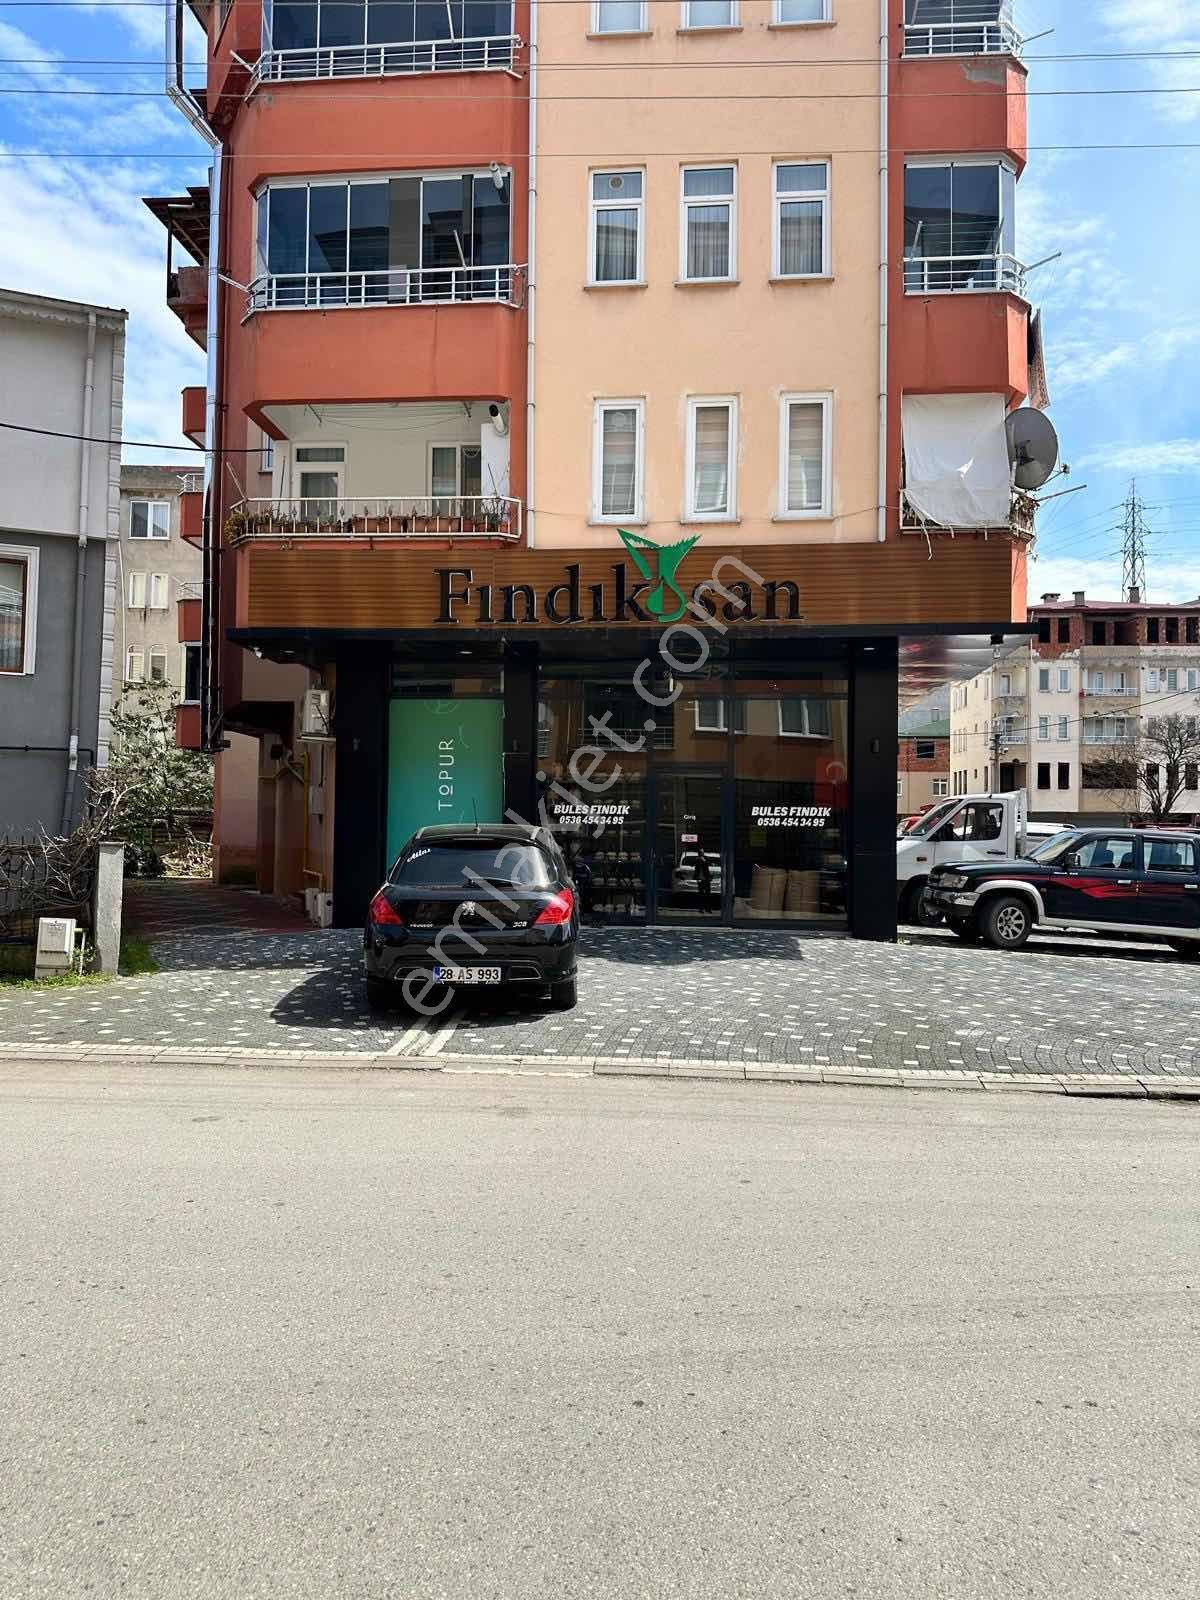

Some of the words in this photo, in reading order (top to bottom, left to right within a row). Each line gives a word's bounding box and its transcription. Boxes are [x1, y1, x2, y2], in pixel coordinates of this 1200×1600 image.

[553, 804, 589, 814] BULES
[590, 805, 631, 815] FINDIK
[751, 806, 788, 816] BULES
[789, 806, 832, 817] FINDIK
[559, 815, 582, 824] 0536
[757, 817, 781, 826] 0536
[781, 817, 799, 827] 454
[799, 818, 812, 827] 34
[812, 818, 826, 827] 95
[440, 969, 454, 981] 28
[457, 969, 473, 981] AS
[478, 969, 500, 981] 993
